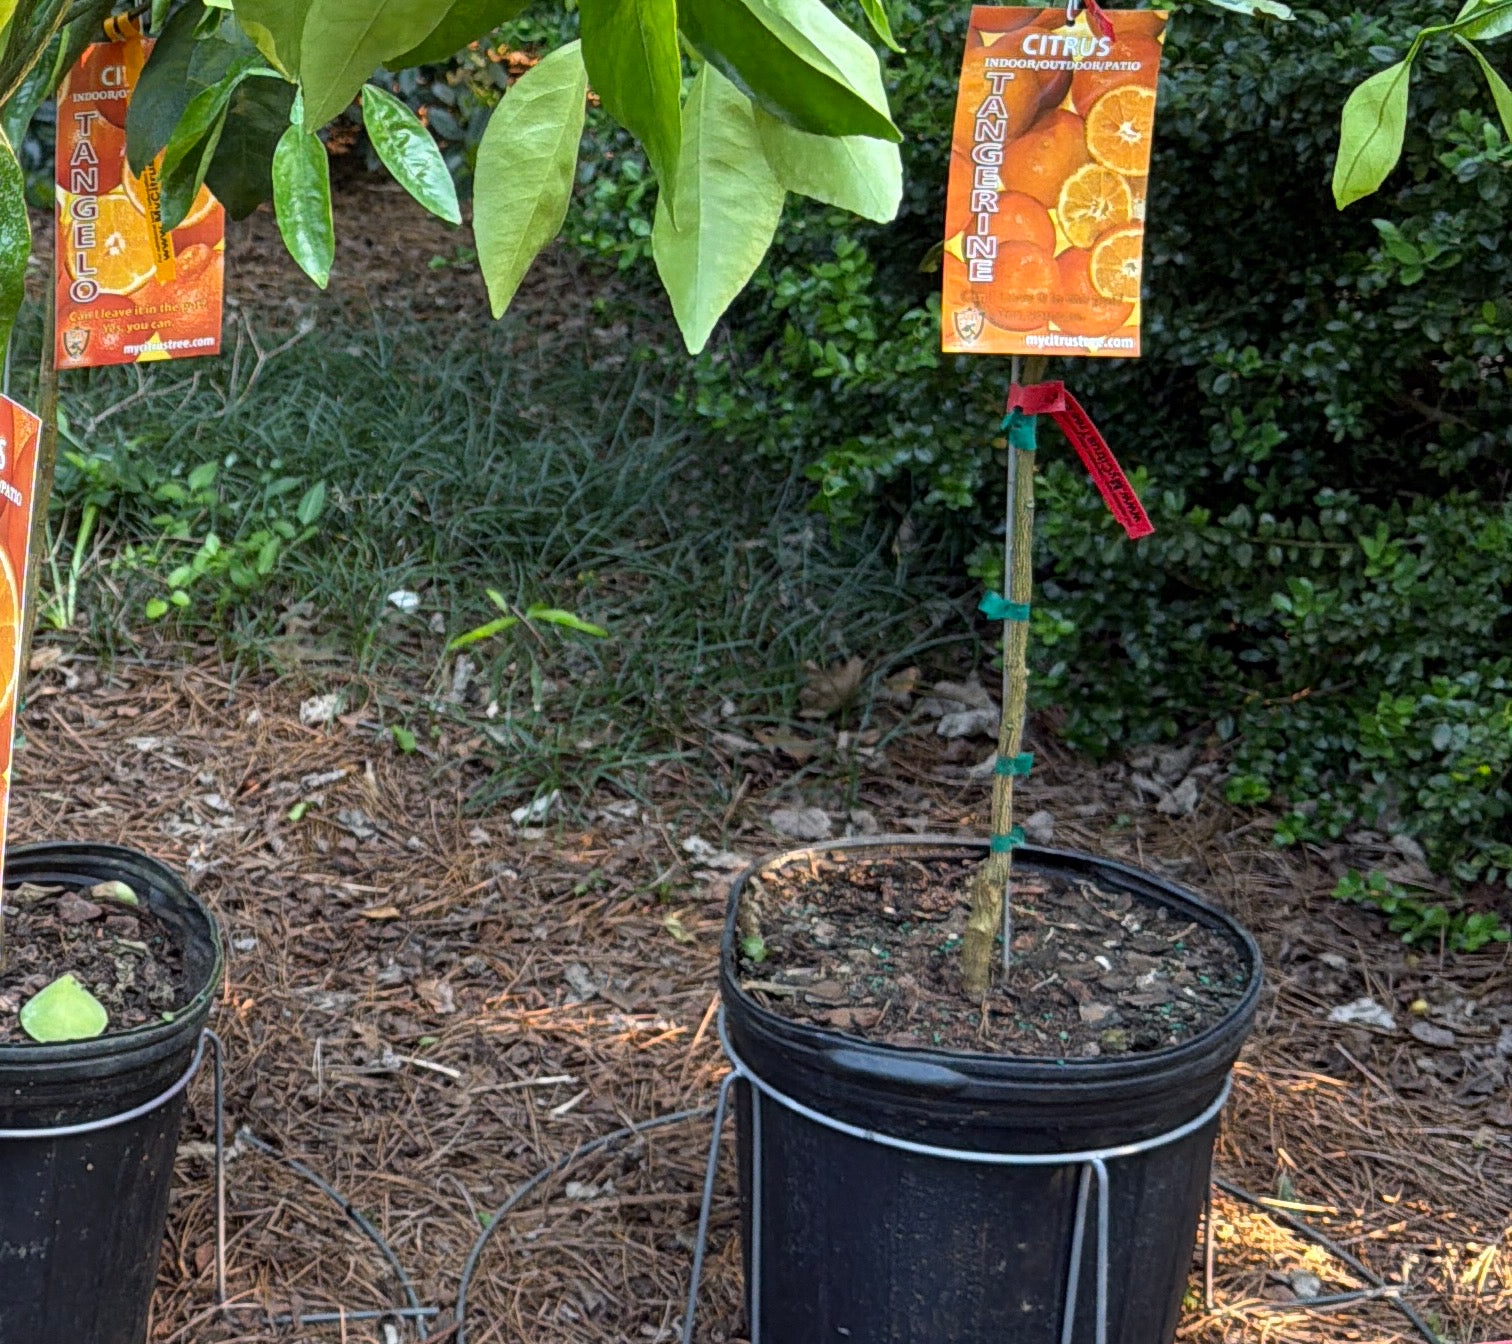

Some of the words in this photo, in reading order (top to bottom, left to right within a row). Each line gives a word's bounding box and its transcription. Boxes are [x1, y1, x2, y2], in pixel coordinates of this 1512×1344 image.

[1022, 33, 1112, 57] CITRUS
[984, 58, 1142, 71] INDOOR/OUTDOOR/PATIO
[966, 72, 1015, 282] TANGERINE
[69, 111, 99, 303] TANGELO
[69, 311, 93, 322] Can
[101, 308, 133, 319] leave
[135, 307, 143, 315] it
[145, 305, 157, 314] in
[159, 303, 178, 312] the
[126, 322, 148, 334] you
[150, 320, 174, 329] can.
[123, 337, 215, 356] mycitrustree.com
